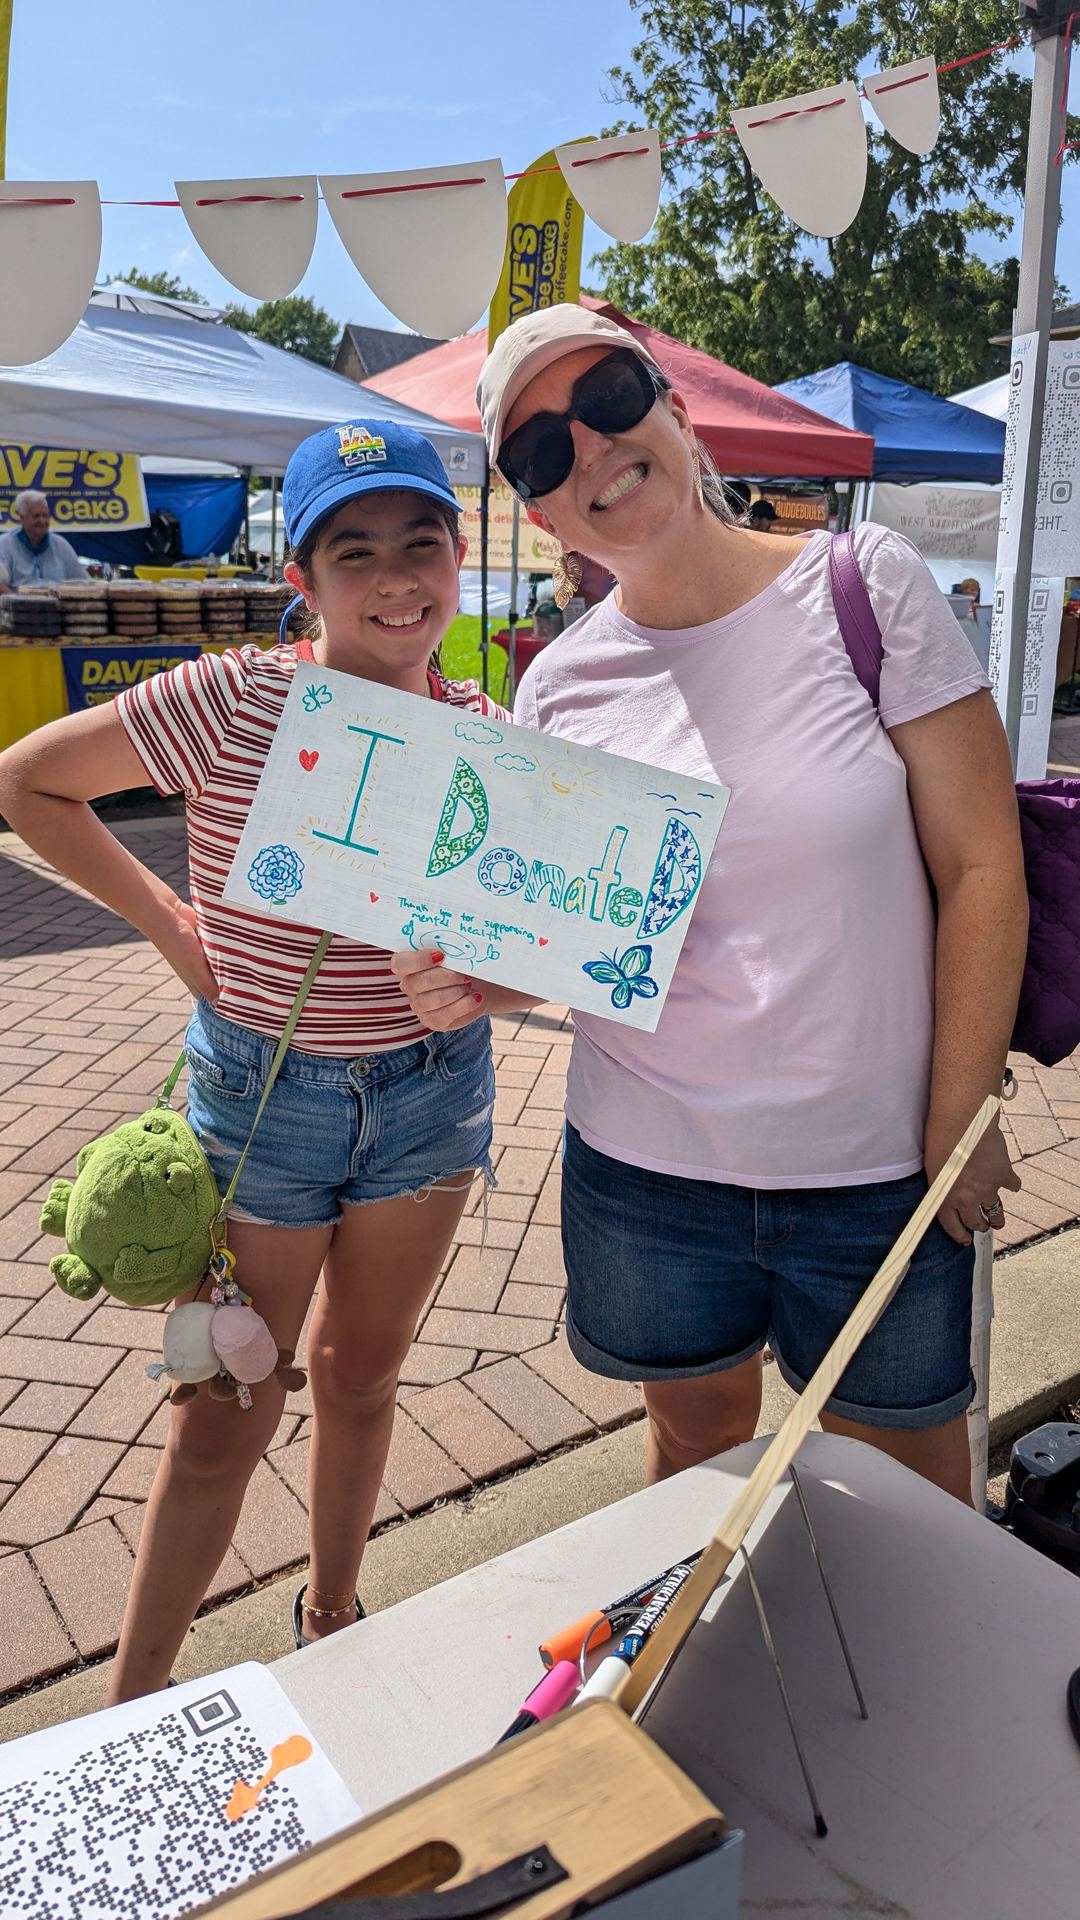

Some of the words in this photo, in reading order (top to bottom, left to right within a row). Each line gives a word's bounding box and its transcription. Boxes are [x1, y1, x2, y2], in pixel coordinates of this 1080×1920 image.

[541, 223, 558, 276] cake
[556, 198, 573, 302] offeecake.com
[335, 425, 387, 467] LA
[55, 499, 125, 520] cake
[900, 515, 924, 528] WEST
[312, 725, 405, 856] I
[397, 896, 429, 912] Thank
[460, 912, 475, 922] for
[484, 920, 535, 944] supporting
[411, 912, 449, 927] mental
[459, 923, 503, 942] health
[626, 1567, 690, 1636] VERSACHALK
